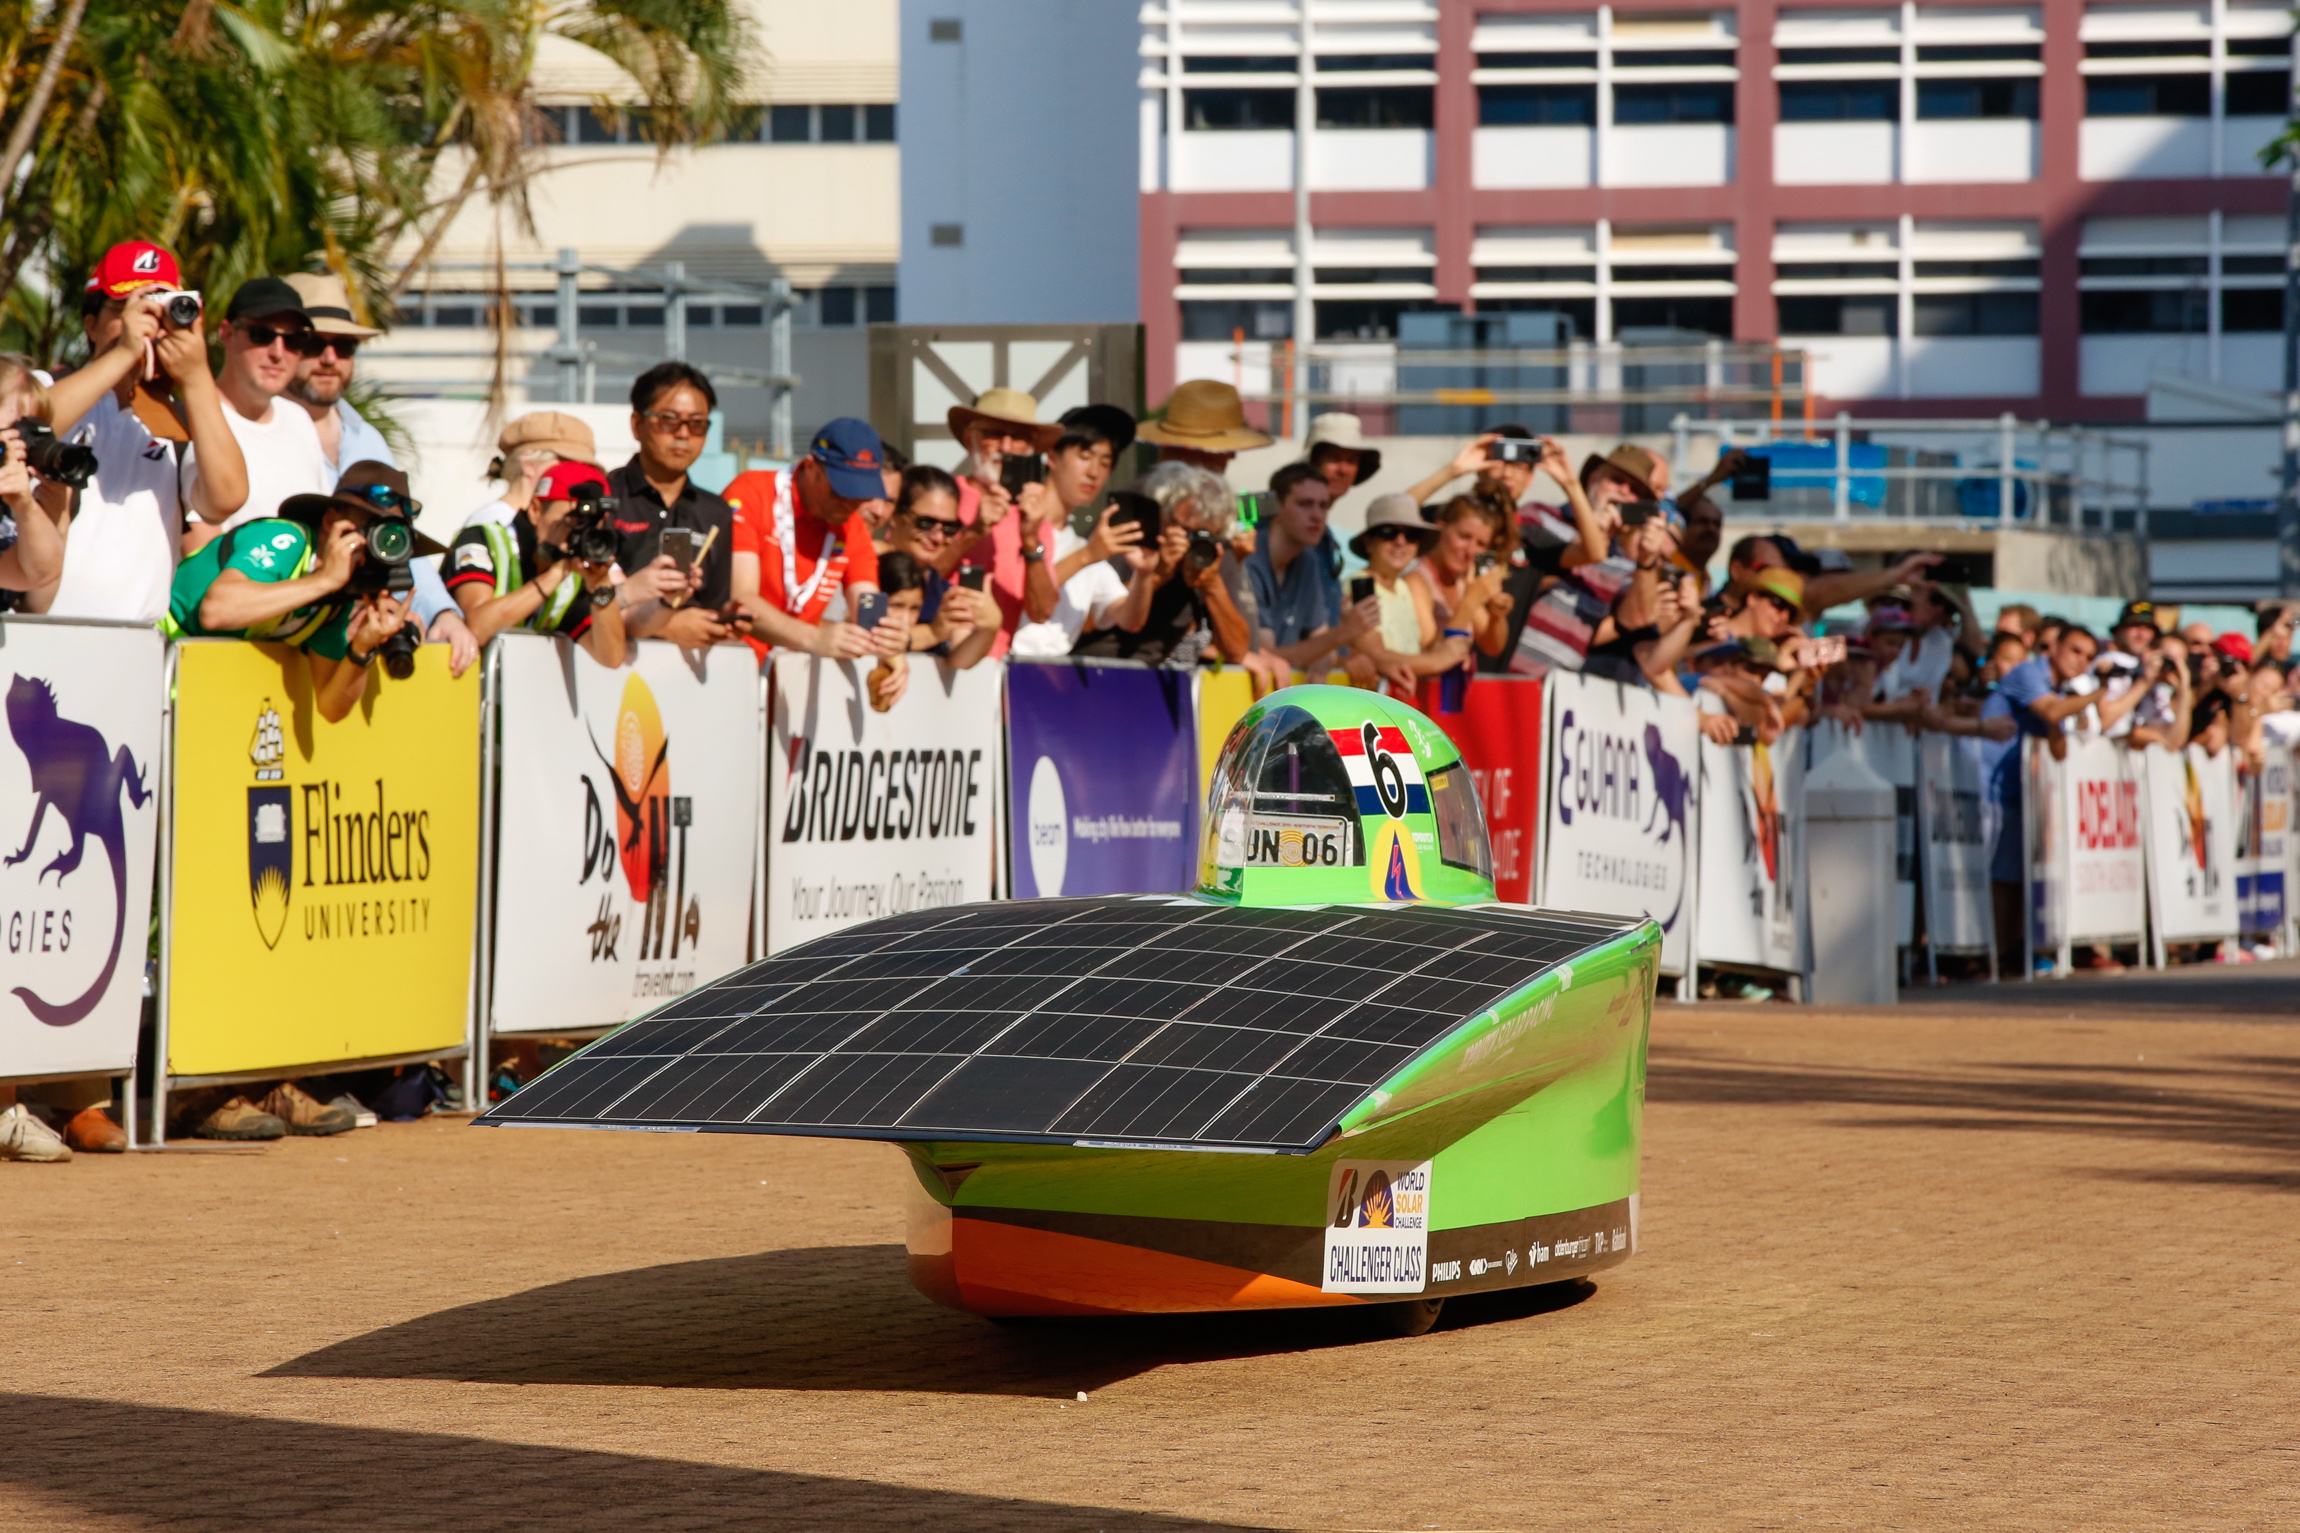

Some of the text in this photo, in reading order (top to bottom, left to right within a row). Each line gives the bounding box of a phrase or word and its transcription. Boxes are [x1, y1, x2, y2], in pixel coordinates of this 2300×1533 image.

[1361, 719, 1408, 820] 6
[1559, 710, 1639, 823] EGUANA
[783, 737, 982, 843] BRIDGESTONE
[301, 778, 431, 887] Flinders
[1302, 832, 1338, 866] 06
[1578, 850, 1667, 891] TECHNOLOGIES
[792, 876, 824, 921] Your
[889, 869, 916, 915] Our
[917, 866, 965, 909] Passion
[0, 908, 73, 954] GIES
[304, 897, 431, 941] UNIVERSITY
[587, 892, 621, 964] the
[1397, 1171, 1425, 1191] WORLD
[1395, 1193, 1423, 1213] SOLAR
[1395, 1217, 1422, 1229] CHALLENGE
[1330, 1245, 1422, 1282] CHALLENGER CLASS
[1432, 1259, 1461, 1282] PHILIPS
[1537, 1241, 1549, 1263] bam
